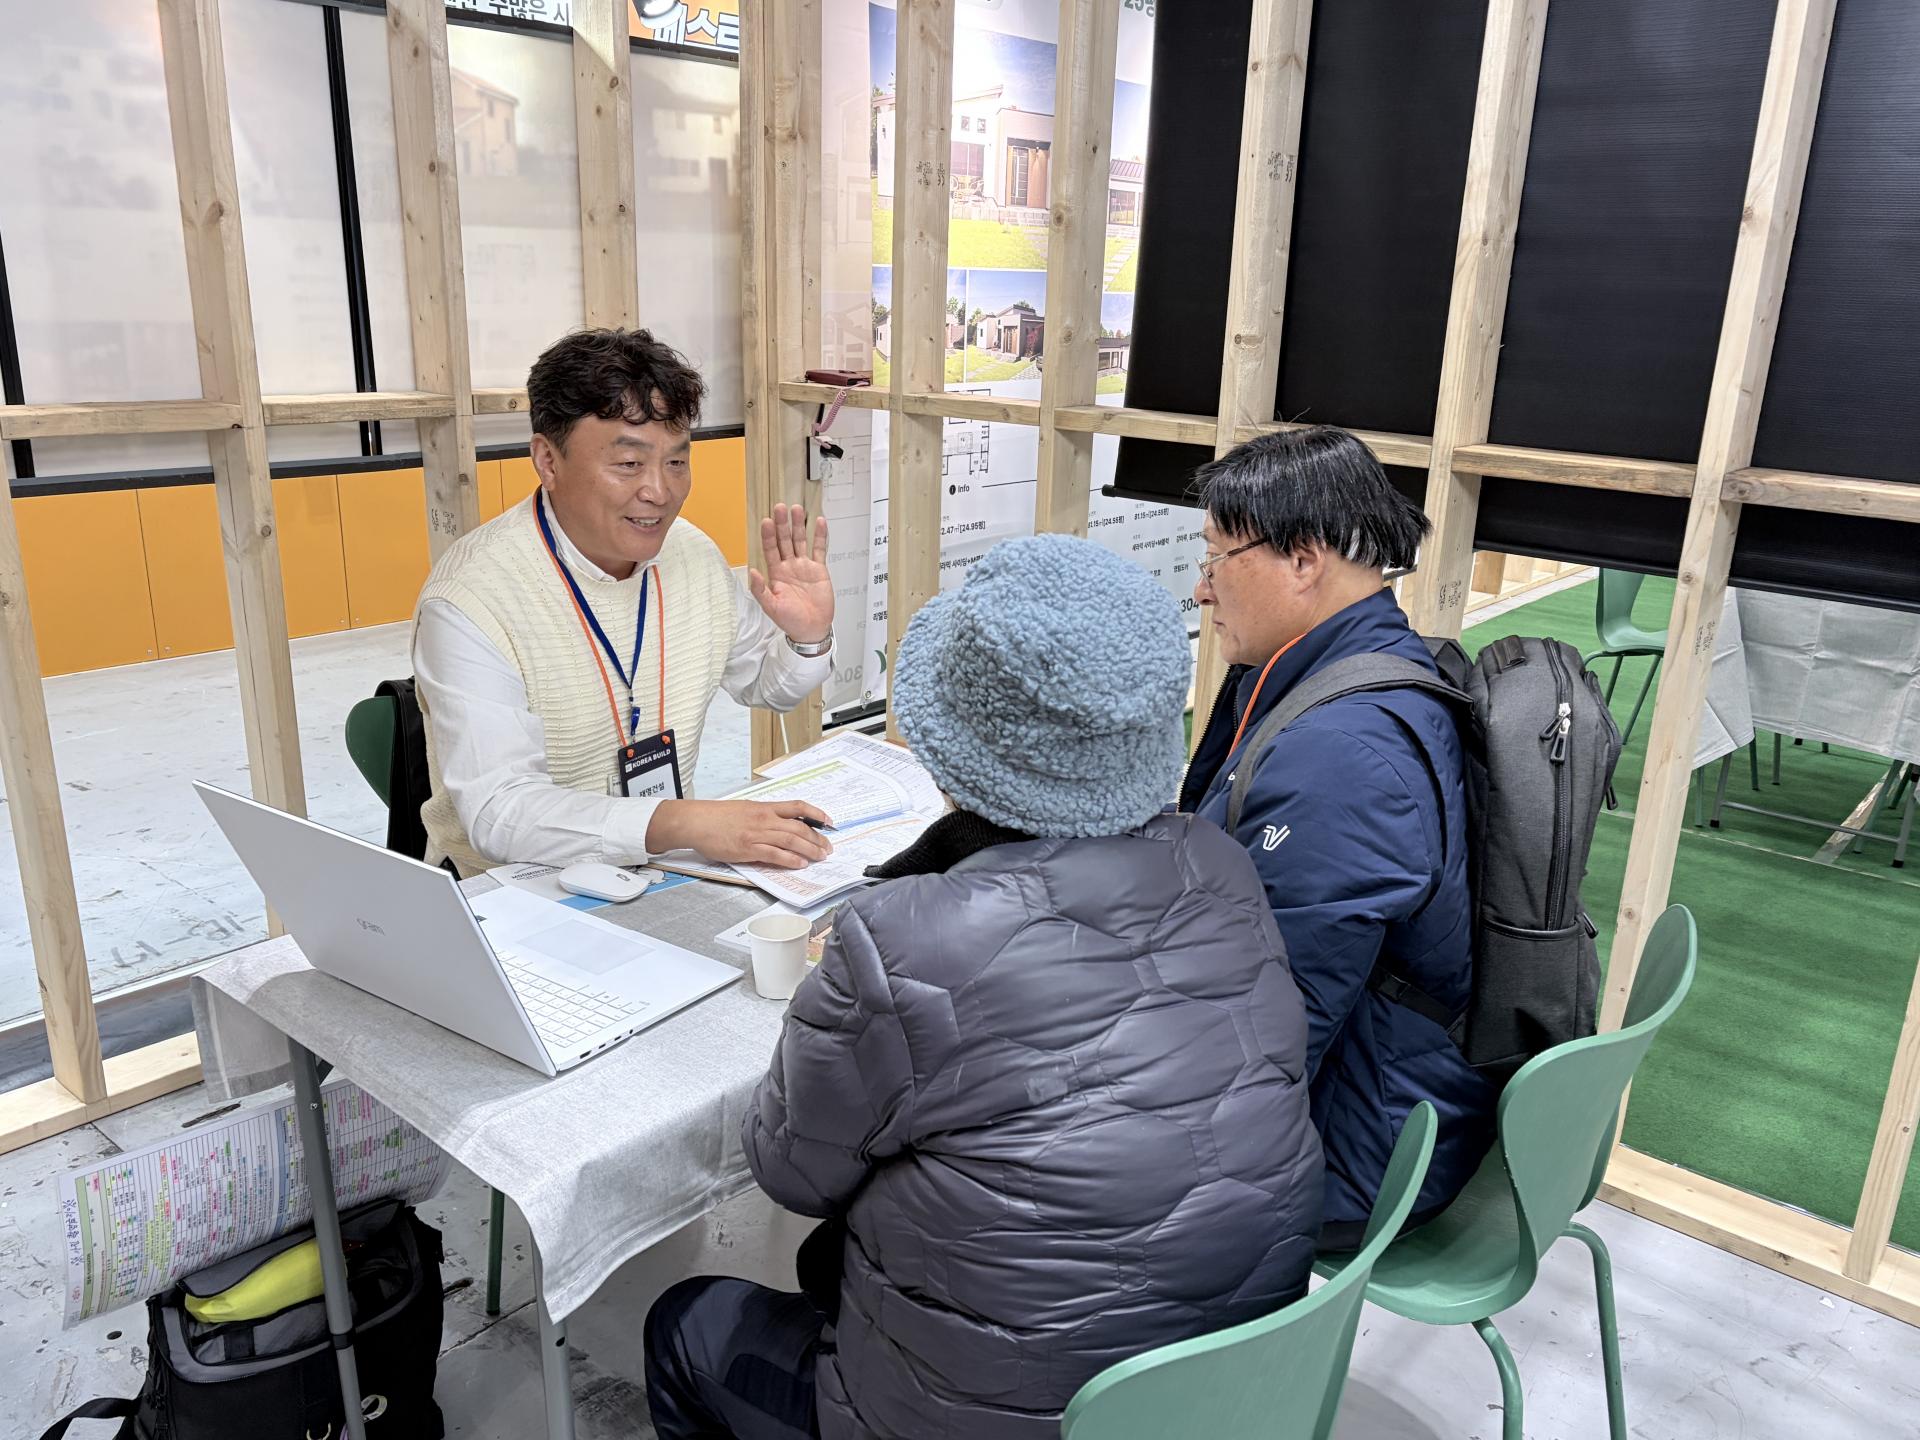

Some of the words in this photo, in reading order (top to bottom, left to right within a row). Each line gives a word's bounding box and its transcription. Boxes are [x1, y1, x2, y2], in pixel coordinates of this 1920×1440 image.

[957, 485, 970, 493] Info
[940, 520, 986, 535] 2.47㎡[24.95평]
[938, 560, 951, 570] 라믹
[1178, 598, 1200, 613] 304
[632, 756, 653, 768] KOREA
[653, 749, 671, 760] BUILD
